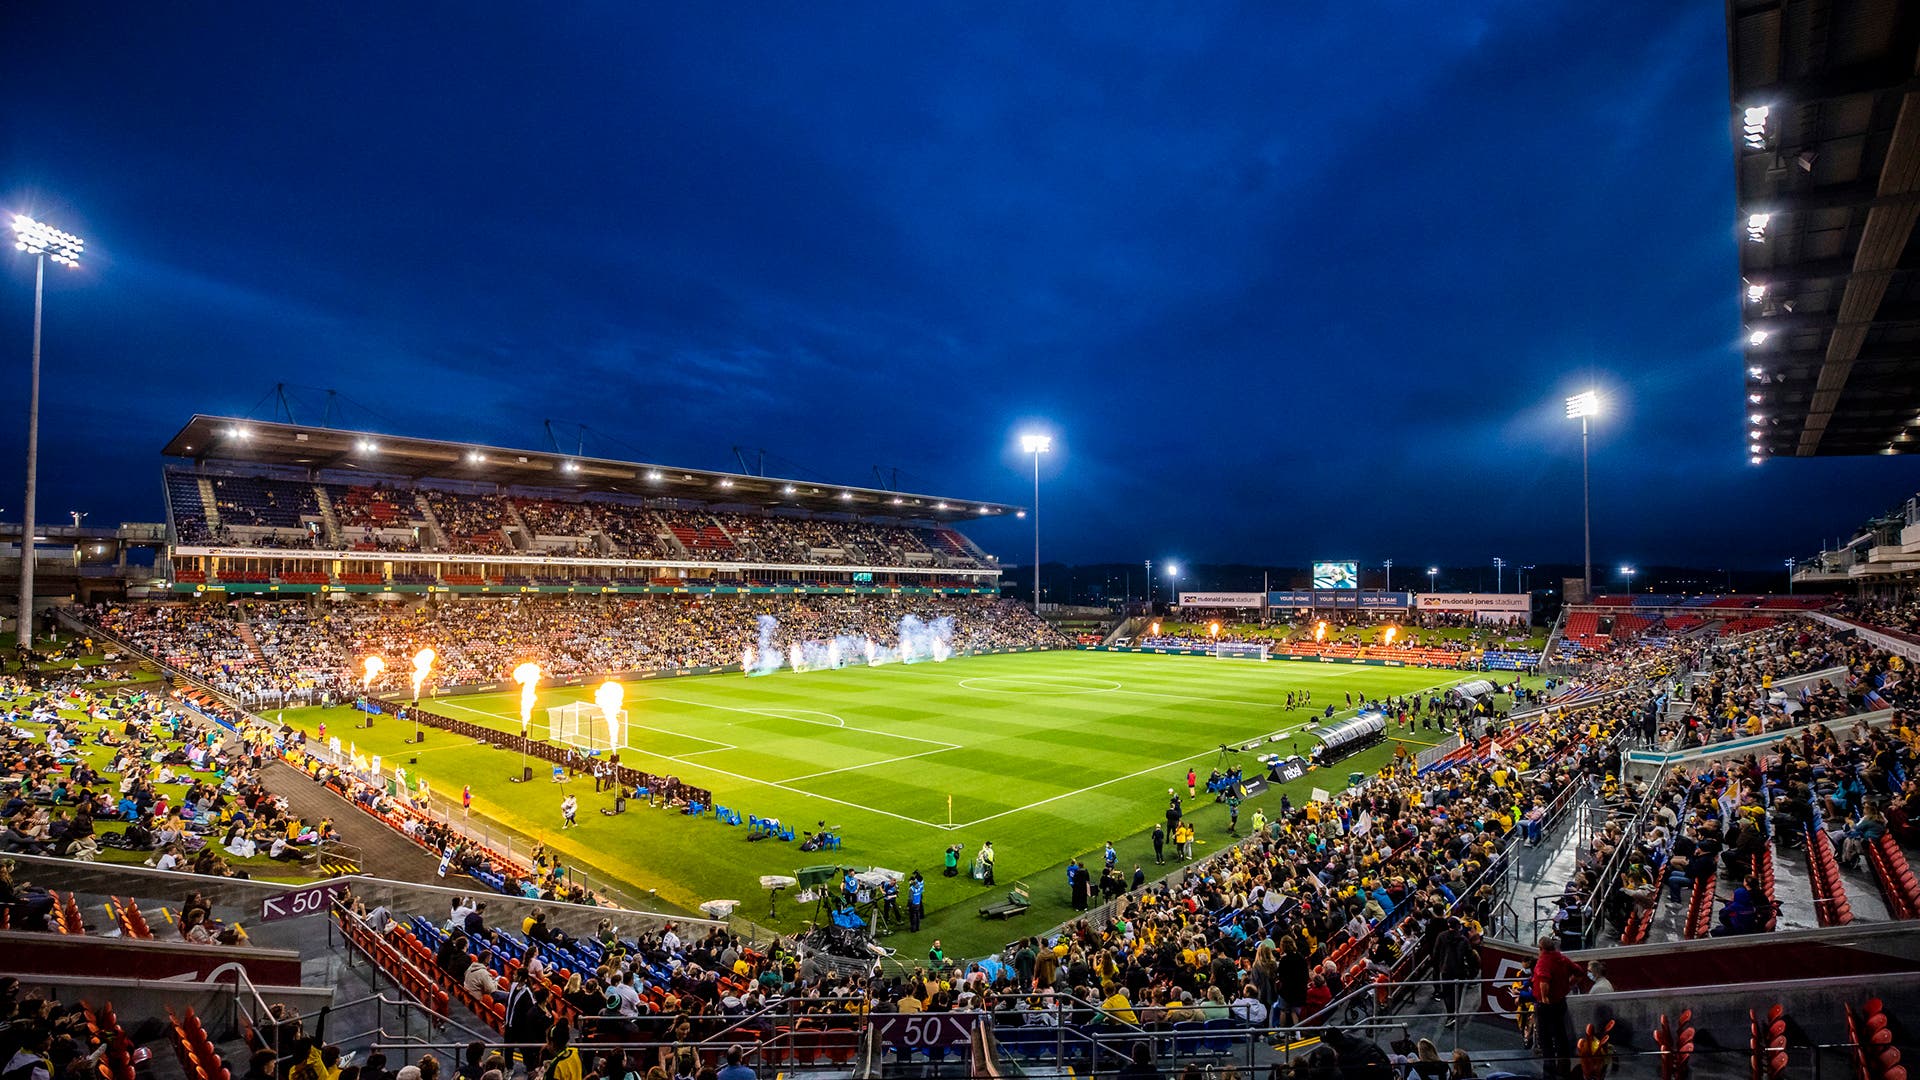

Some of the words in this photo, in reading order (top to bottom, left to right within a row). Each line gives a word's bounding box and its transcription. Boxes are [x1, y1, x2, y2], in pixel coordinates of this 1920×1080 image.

[1474, 598, 1494, 606] jones
[1283, 763, 1303, 780] rebel
[292, 889, 322, 913] 50
[903, 1016, 942, 1046] 50
